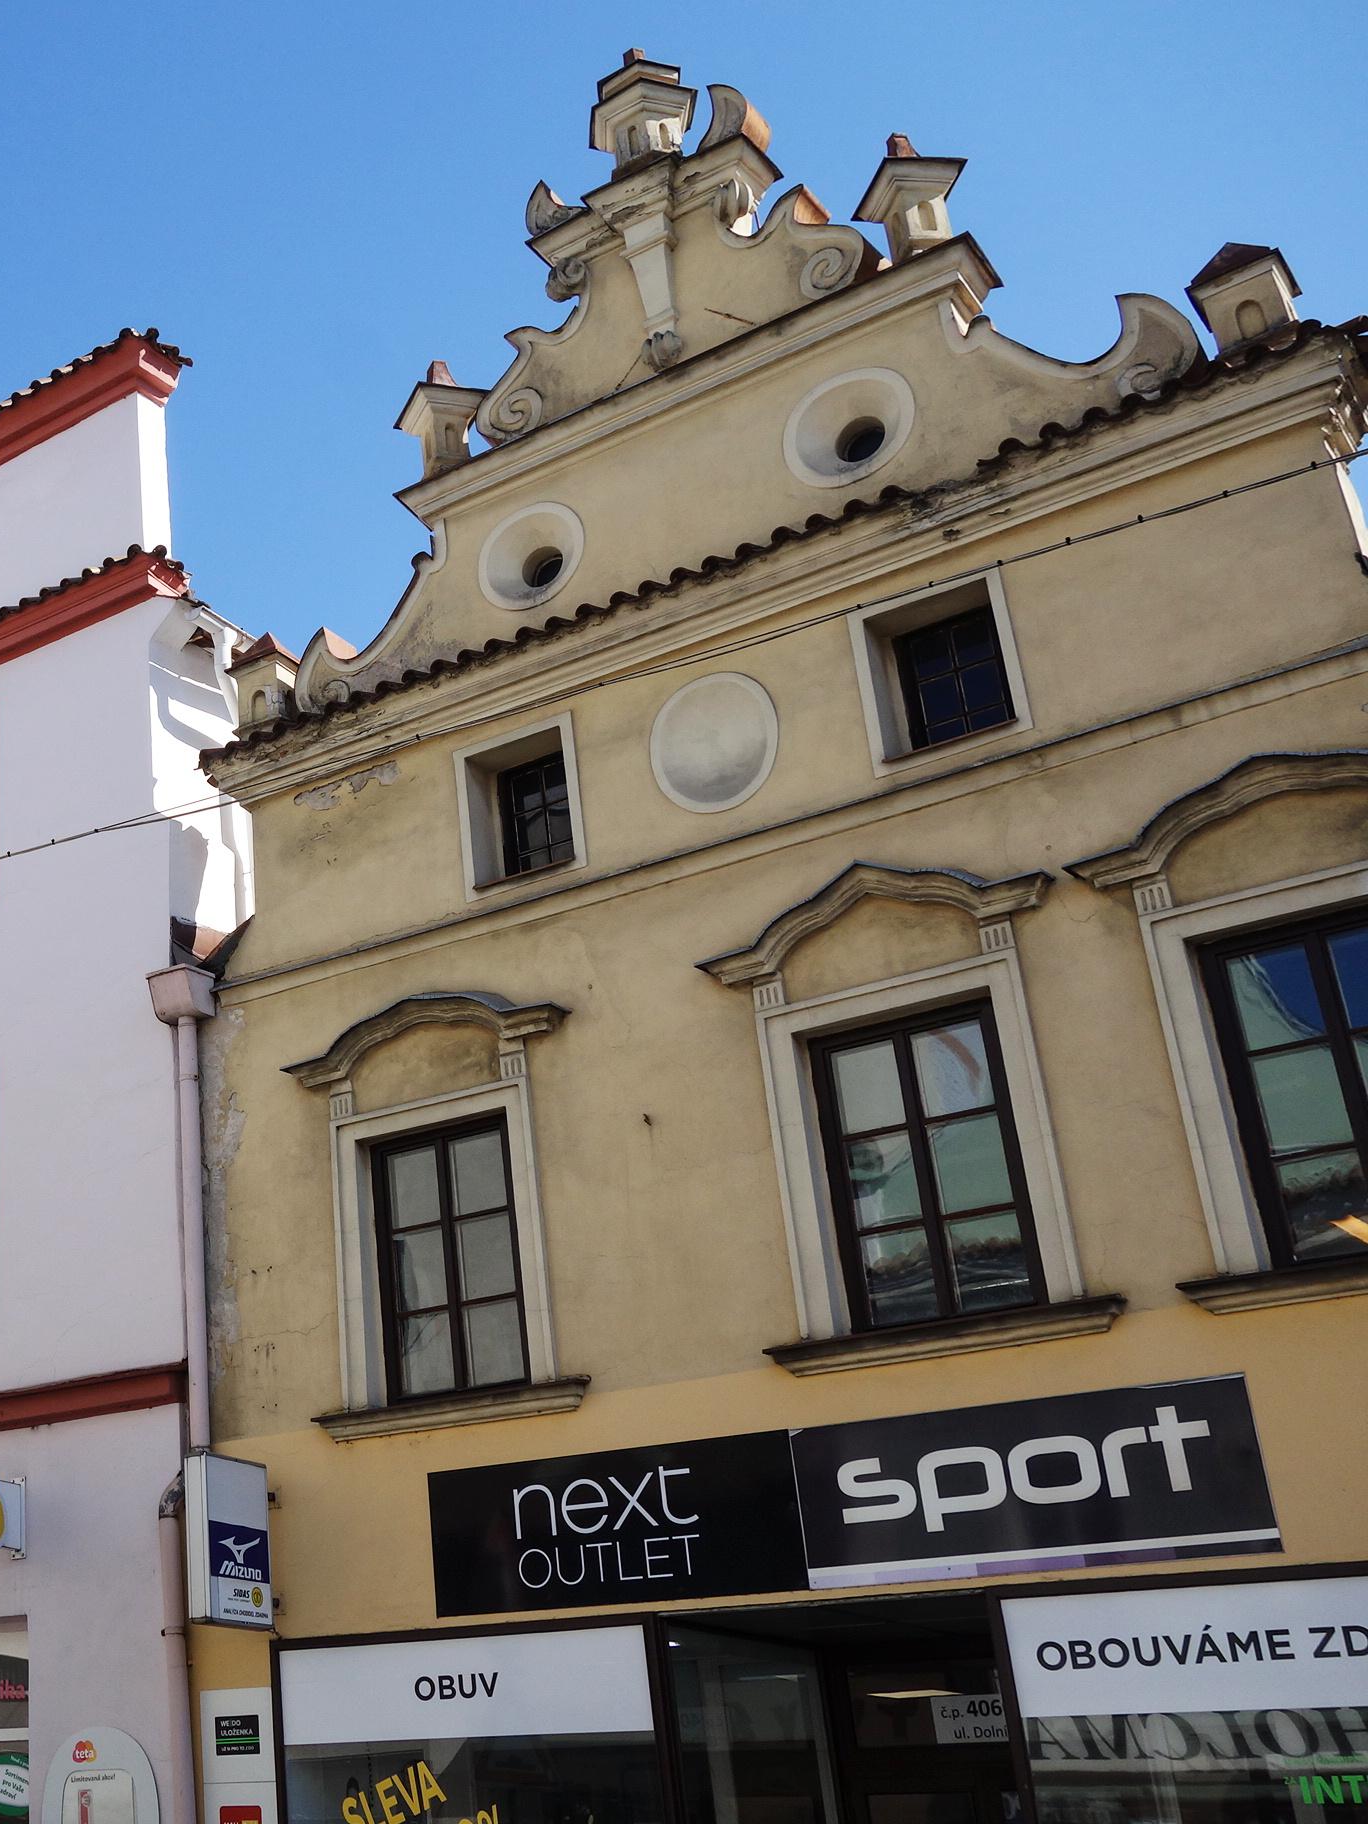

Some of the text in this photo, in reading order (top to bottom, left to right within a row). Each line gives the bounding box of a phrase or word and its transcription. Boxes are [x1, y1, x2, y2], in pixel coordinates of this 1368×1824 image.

[837, 1405, 1211, 1532] sport
[513, 1466, 699, 1540] next
[219, 1560, 262, 1580] MIZUNO
[518, 1534, 700, 1589] OUTLET
[1036, 1625, 1295, 1671] OBOUVÁME
[414, 1672, 499, 1702] OBUV
[940, 1698, 1003, 1720] č.p. 406
[953, 1726, 970, 1739] ul.
[75, 1749, 94, 1759] teta
[342, 1761, 447, 1824] SLEVA
[1299, 1775, 1368, 1805] INT
